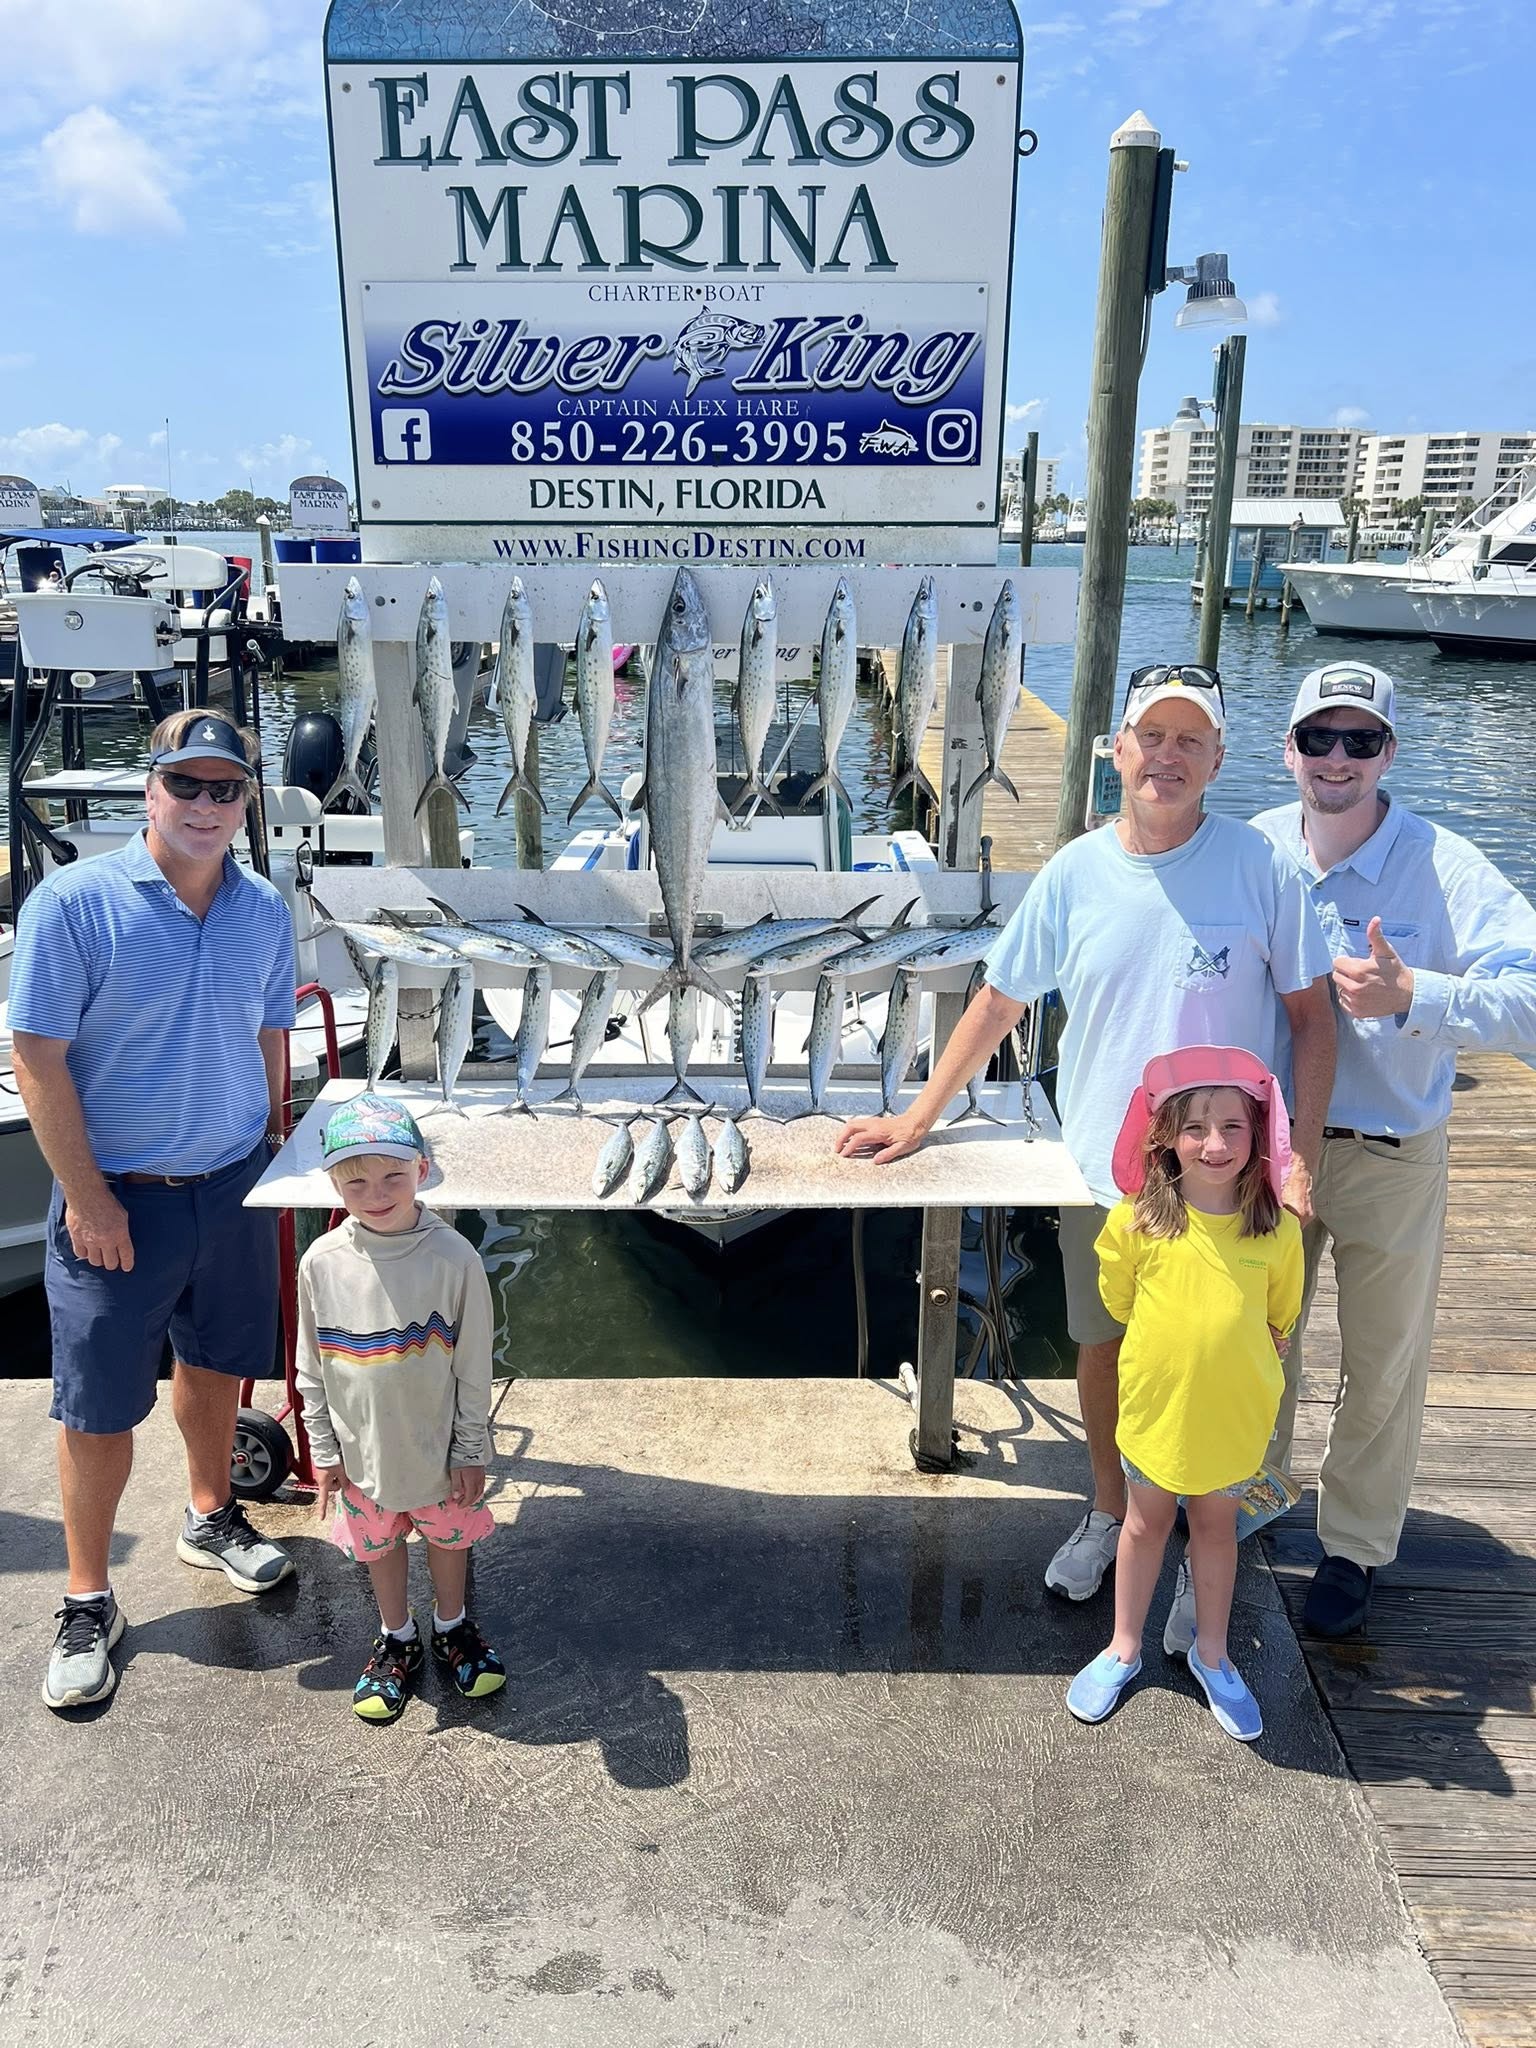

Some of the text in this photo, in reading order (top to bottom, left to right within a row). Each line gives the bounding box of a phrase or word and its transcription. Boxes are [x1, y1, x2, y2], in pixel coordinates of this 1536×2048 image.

[368, 71, 975, 171] EAST PASS
[445, 184, 899, 273] MARINA
[588, 285, 765, 301] CHARTER BOAT
[378, 313, 982, 404] Silver King
[557, 399, 799, 416] CAPTAIN ALEX HARE
[511, 420, 847, 462] 850-226-3995
[0, 500, 30, 508] ARINA
[293, 491, 344, 500] EAST PASS
[300, 500, 338, 508] MARINA
[529, 478, 827, 516] DESTIN, FLORIDA
[775, 647, 800, 661] ng
